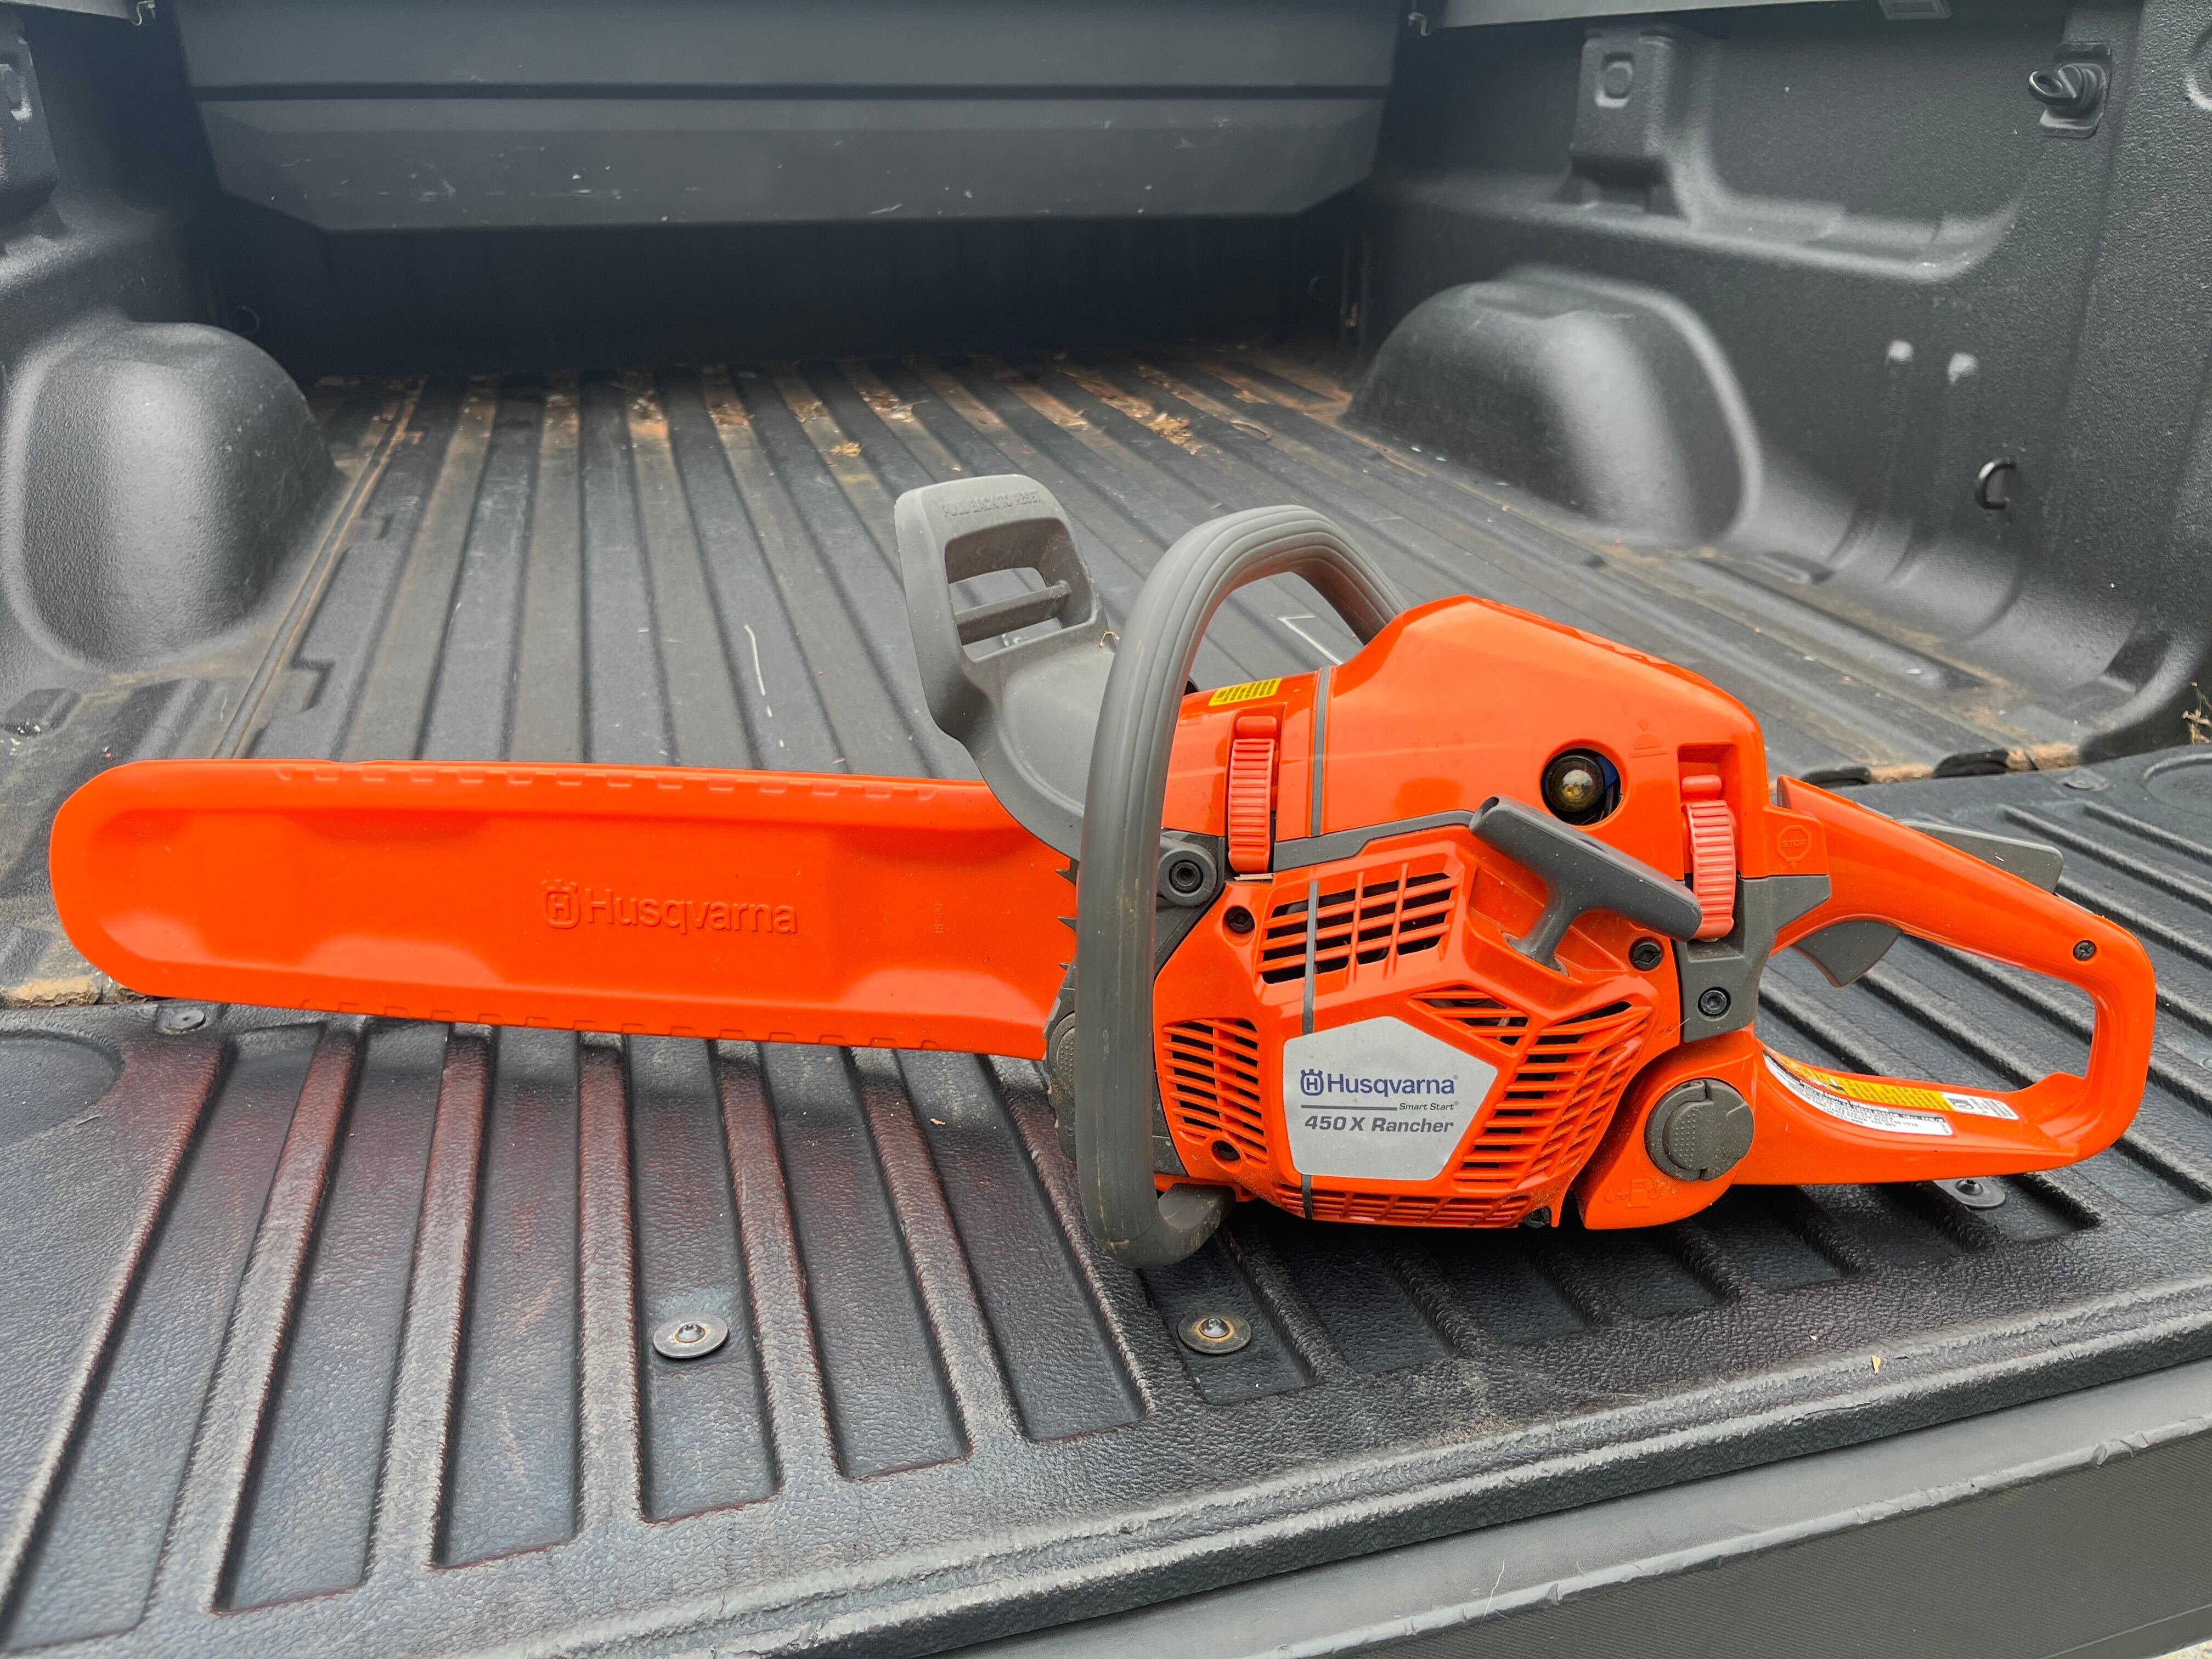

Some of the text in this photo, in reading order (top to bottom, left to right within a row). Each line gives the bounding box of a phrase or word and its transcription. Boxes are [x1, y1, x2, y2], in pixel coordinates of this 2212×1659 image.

[1782, 839, 1807, 848] STOP
[585, 888, 797, 934] Husqvarna
[1327, 1073, 1454, 1097] Husqvarna
[1305, 1115, 1454, 1132] 450 X Rancher
